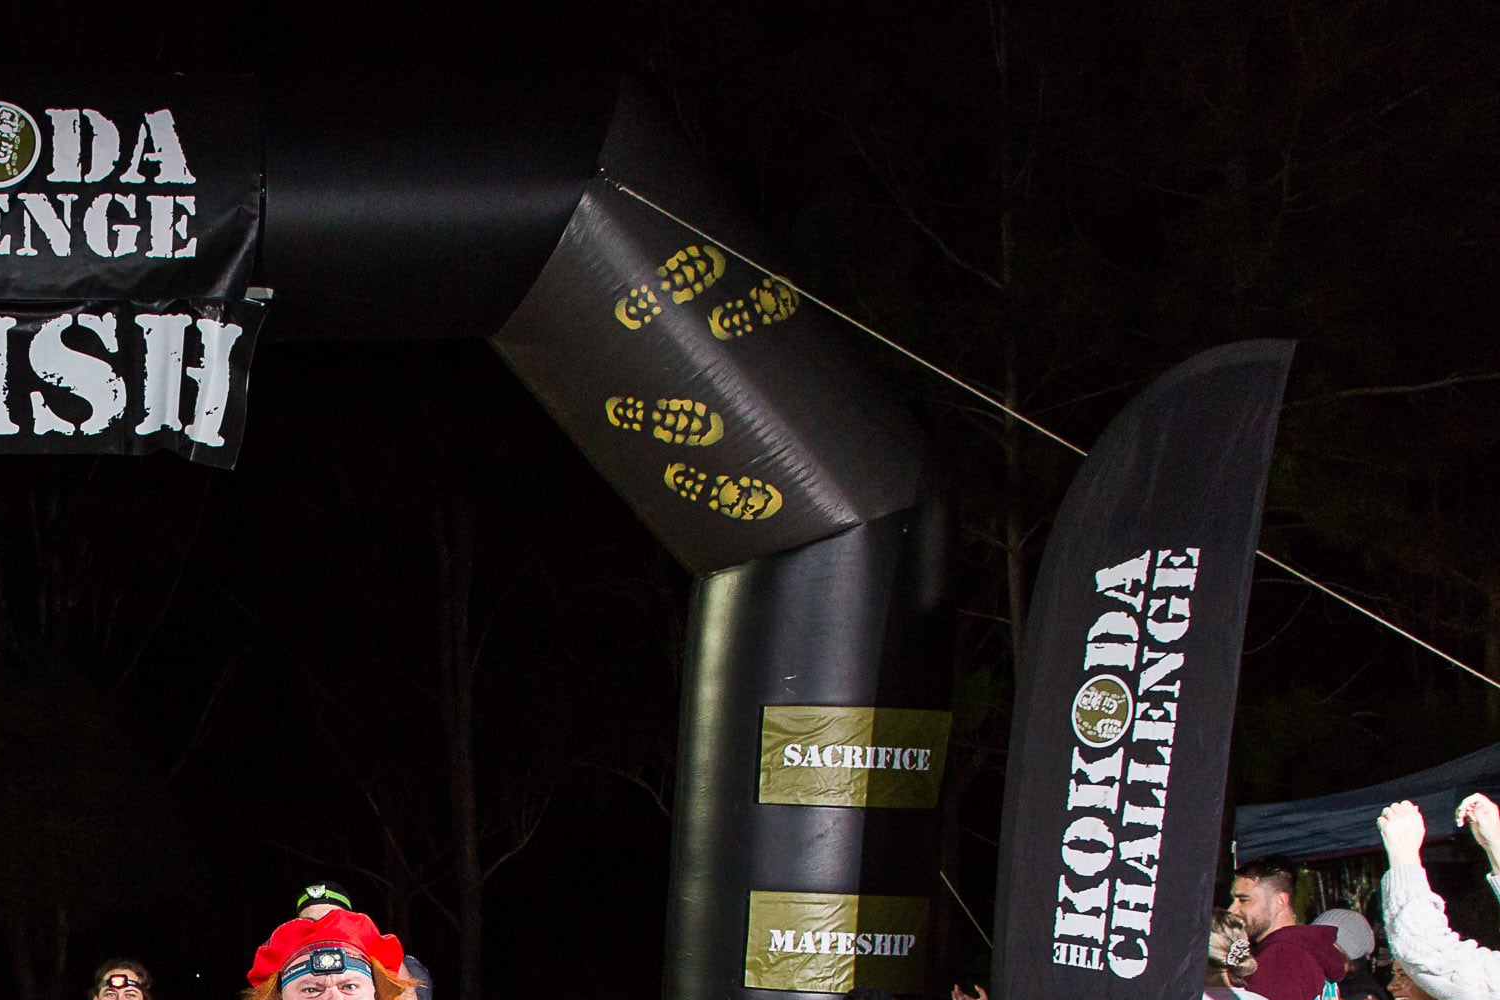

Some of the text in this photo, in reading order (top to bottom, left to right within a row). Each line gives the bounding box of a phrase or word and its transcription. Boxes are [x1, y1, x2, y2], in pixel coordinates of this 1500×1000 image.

[783, 743, 932, 771] SACRIFICE
[1109, 547, 1200, 979] CHALLENGE
[768, 929, 916, 957] MATESHIP
[1053, 941, 1105, 971] THE
